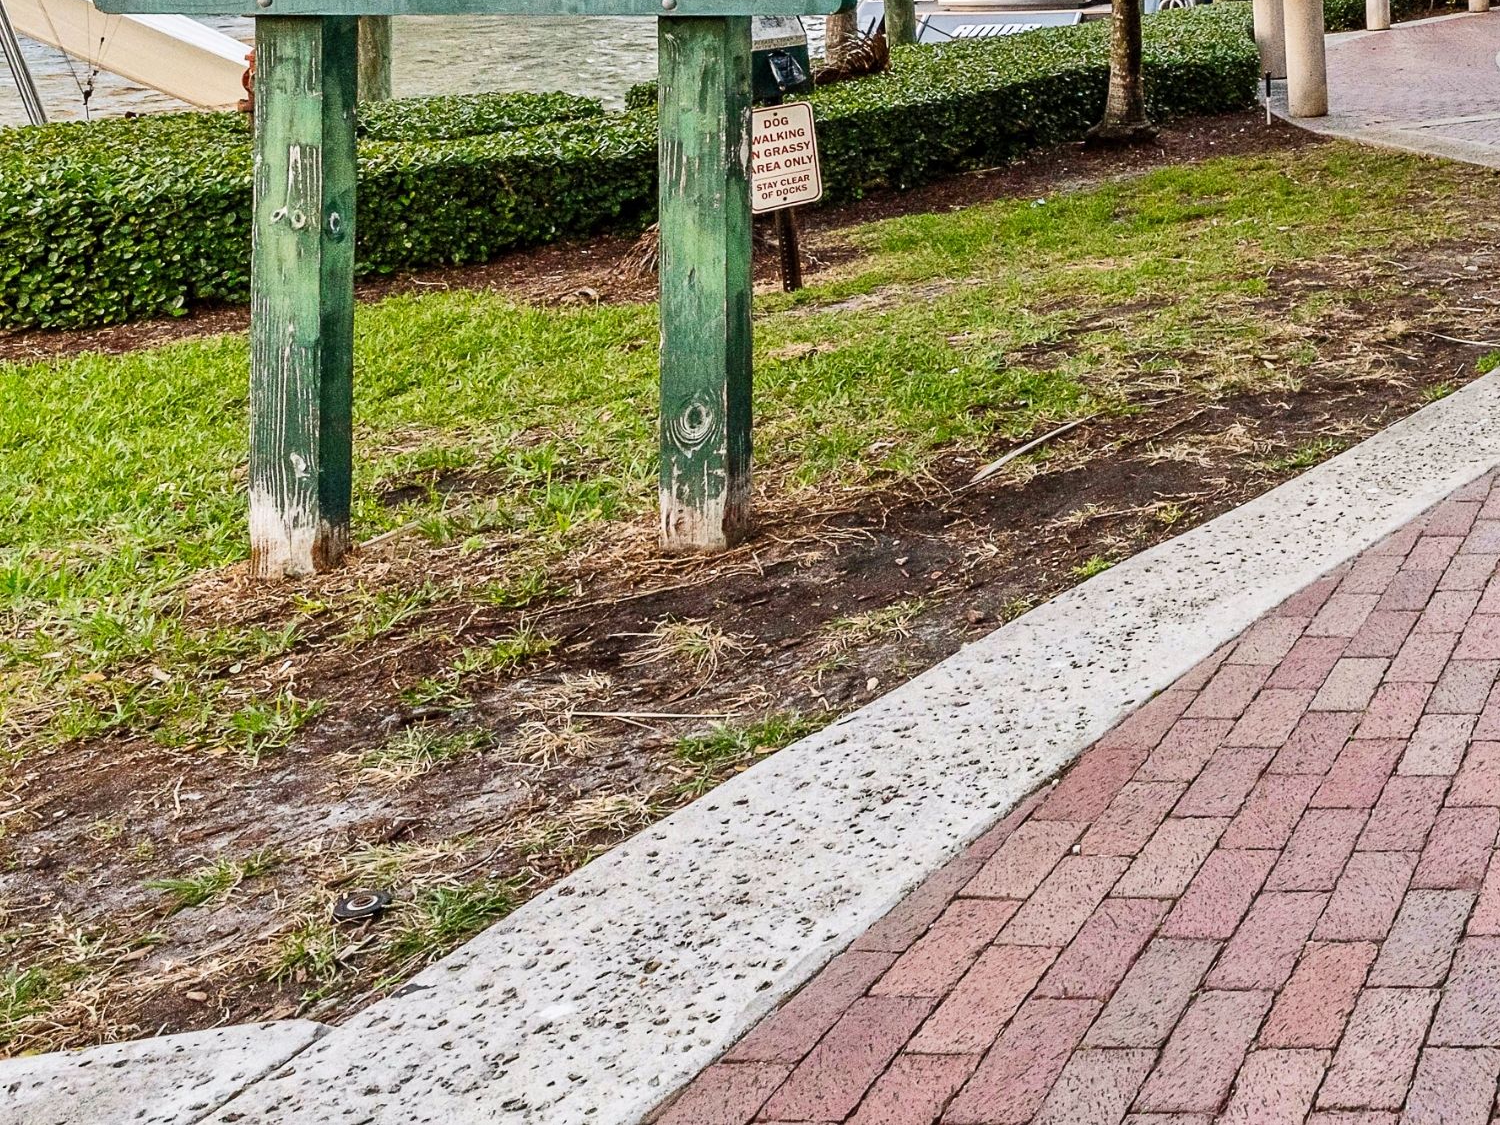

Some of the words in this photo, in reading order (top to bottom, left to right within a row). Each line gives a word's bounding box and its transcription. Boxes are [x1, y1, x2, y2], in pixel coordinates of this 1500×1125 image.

[764, 116, 789, 129] DOG
[752, 127, 805, 146] WALKING
[764, 140, 811, 158] GRASSY
[784, 154, 813, 168] ONLY
[756, 180, 778, 192] STAY
[780, 174, 810, 187] CLEAR
[761, 190, 773, 200] OF
[776, 183, 808, 197] DOCKS
